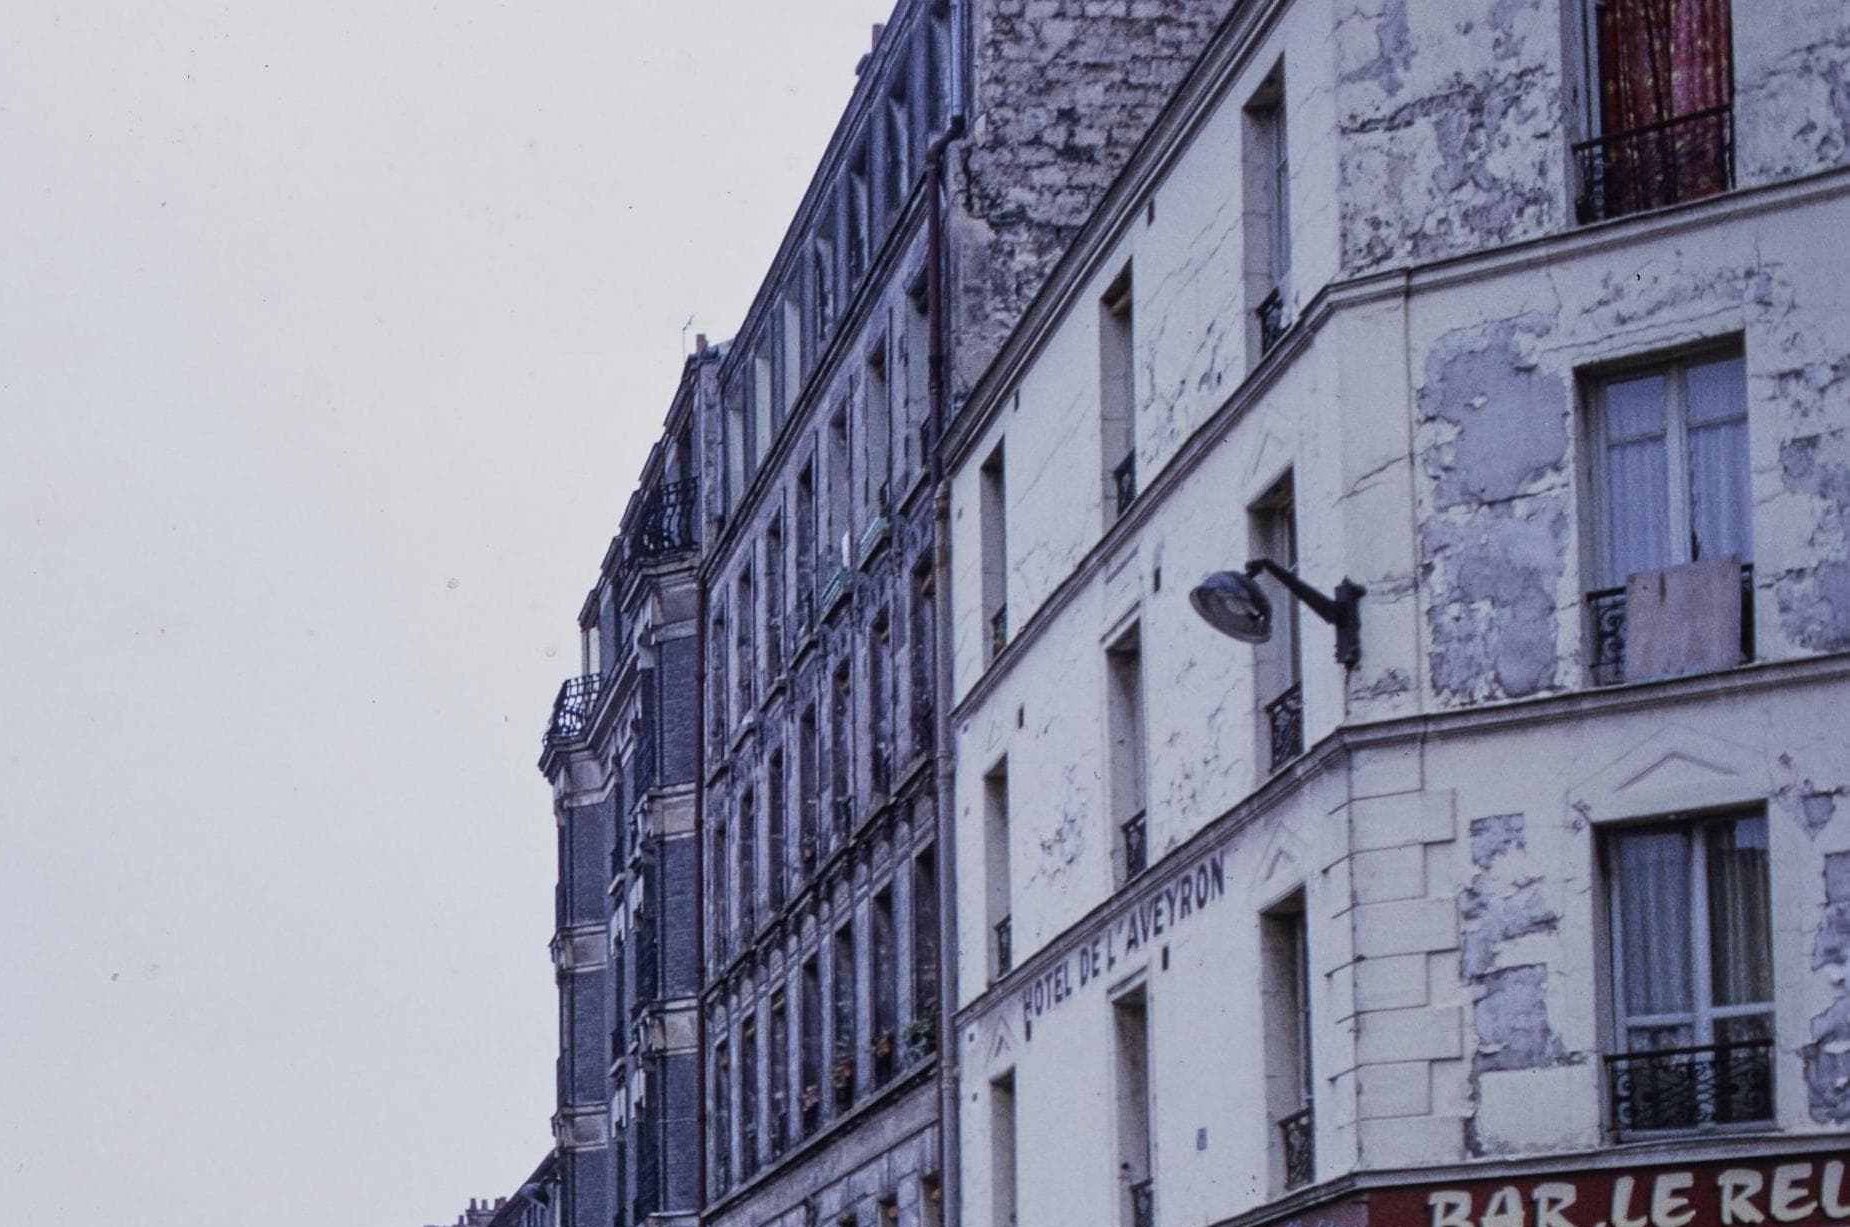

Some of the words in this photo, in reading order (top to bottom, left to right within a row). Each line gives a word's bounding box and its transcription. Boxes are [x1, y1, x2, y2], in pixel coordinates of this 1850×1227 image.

[1023, 959, 1073, 1020] HOTEL
[1080, 937, 1101, 987] DE
[1106, 848, 1226, 974] L'AVEYRON
[1716, 1159, 1850, 1226] REL
